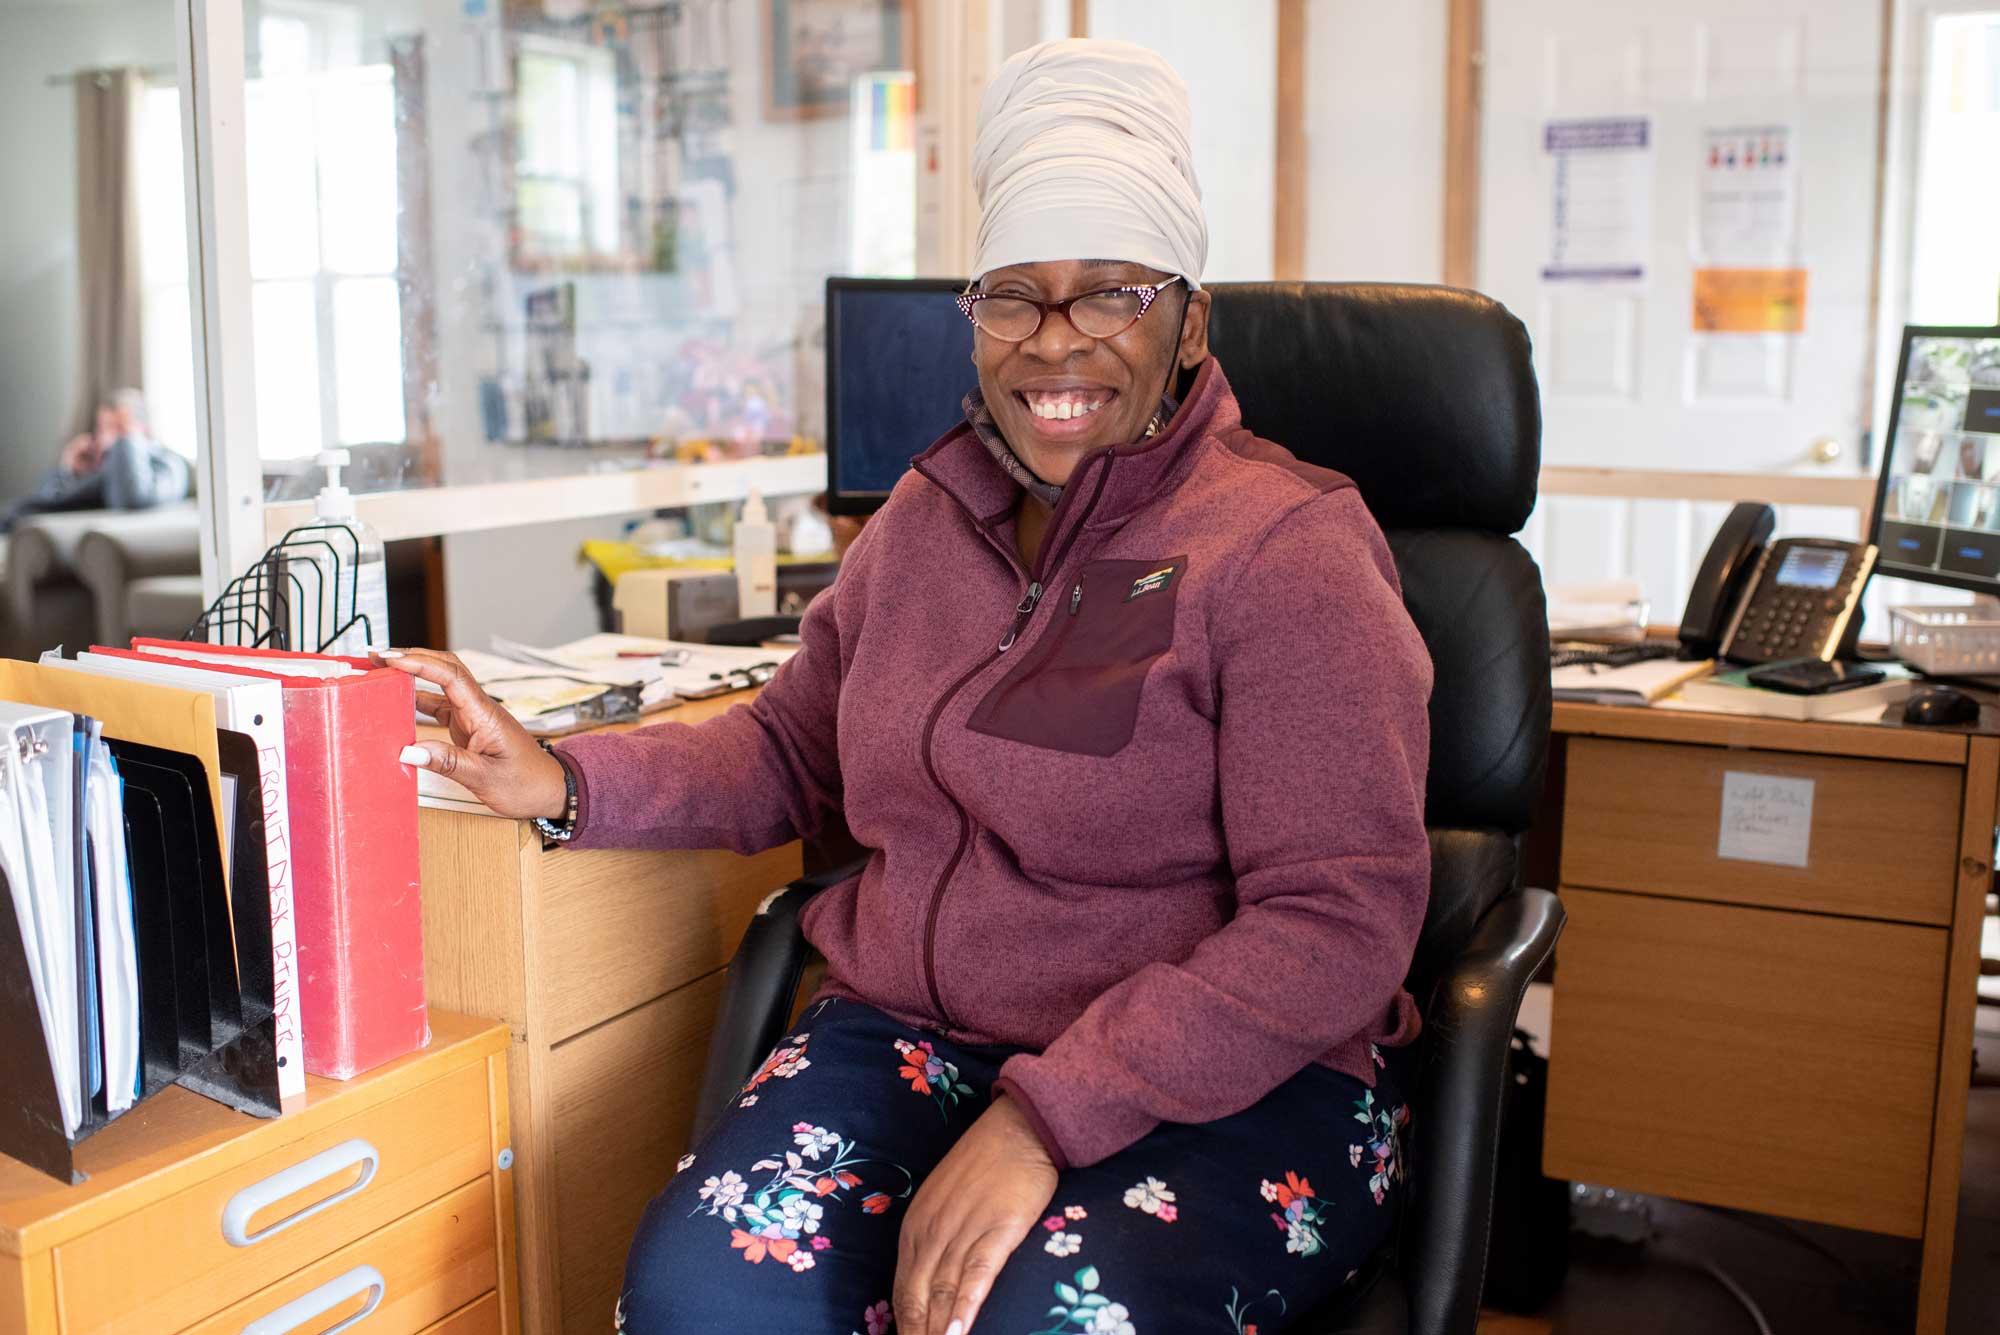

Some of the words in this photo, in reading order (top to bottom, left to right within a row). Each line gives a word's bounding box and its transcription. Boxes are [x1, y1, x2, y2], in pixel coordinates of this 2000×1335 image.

[257, 745, 287, 851] FRONT
[267, 859, 289, 929] DESK
[273, 940, 293, 1046] BINDER
